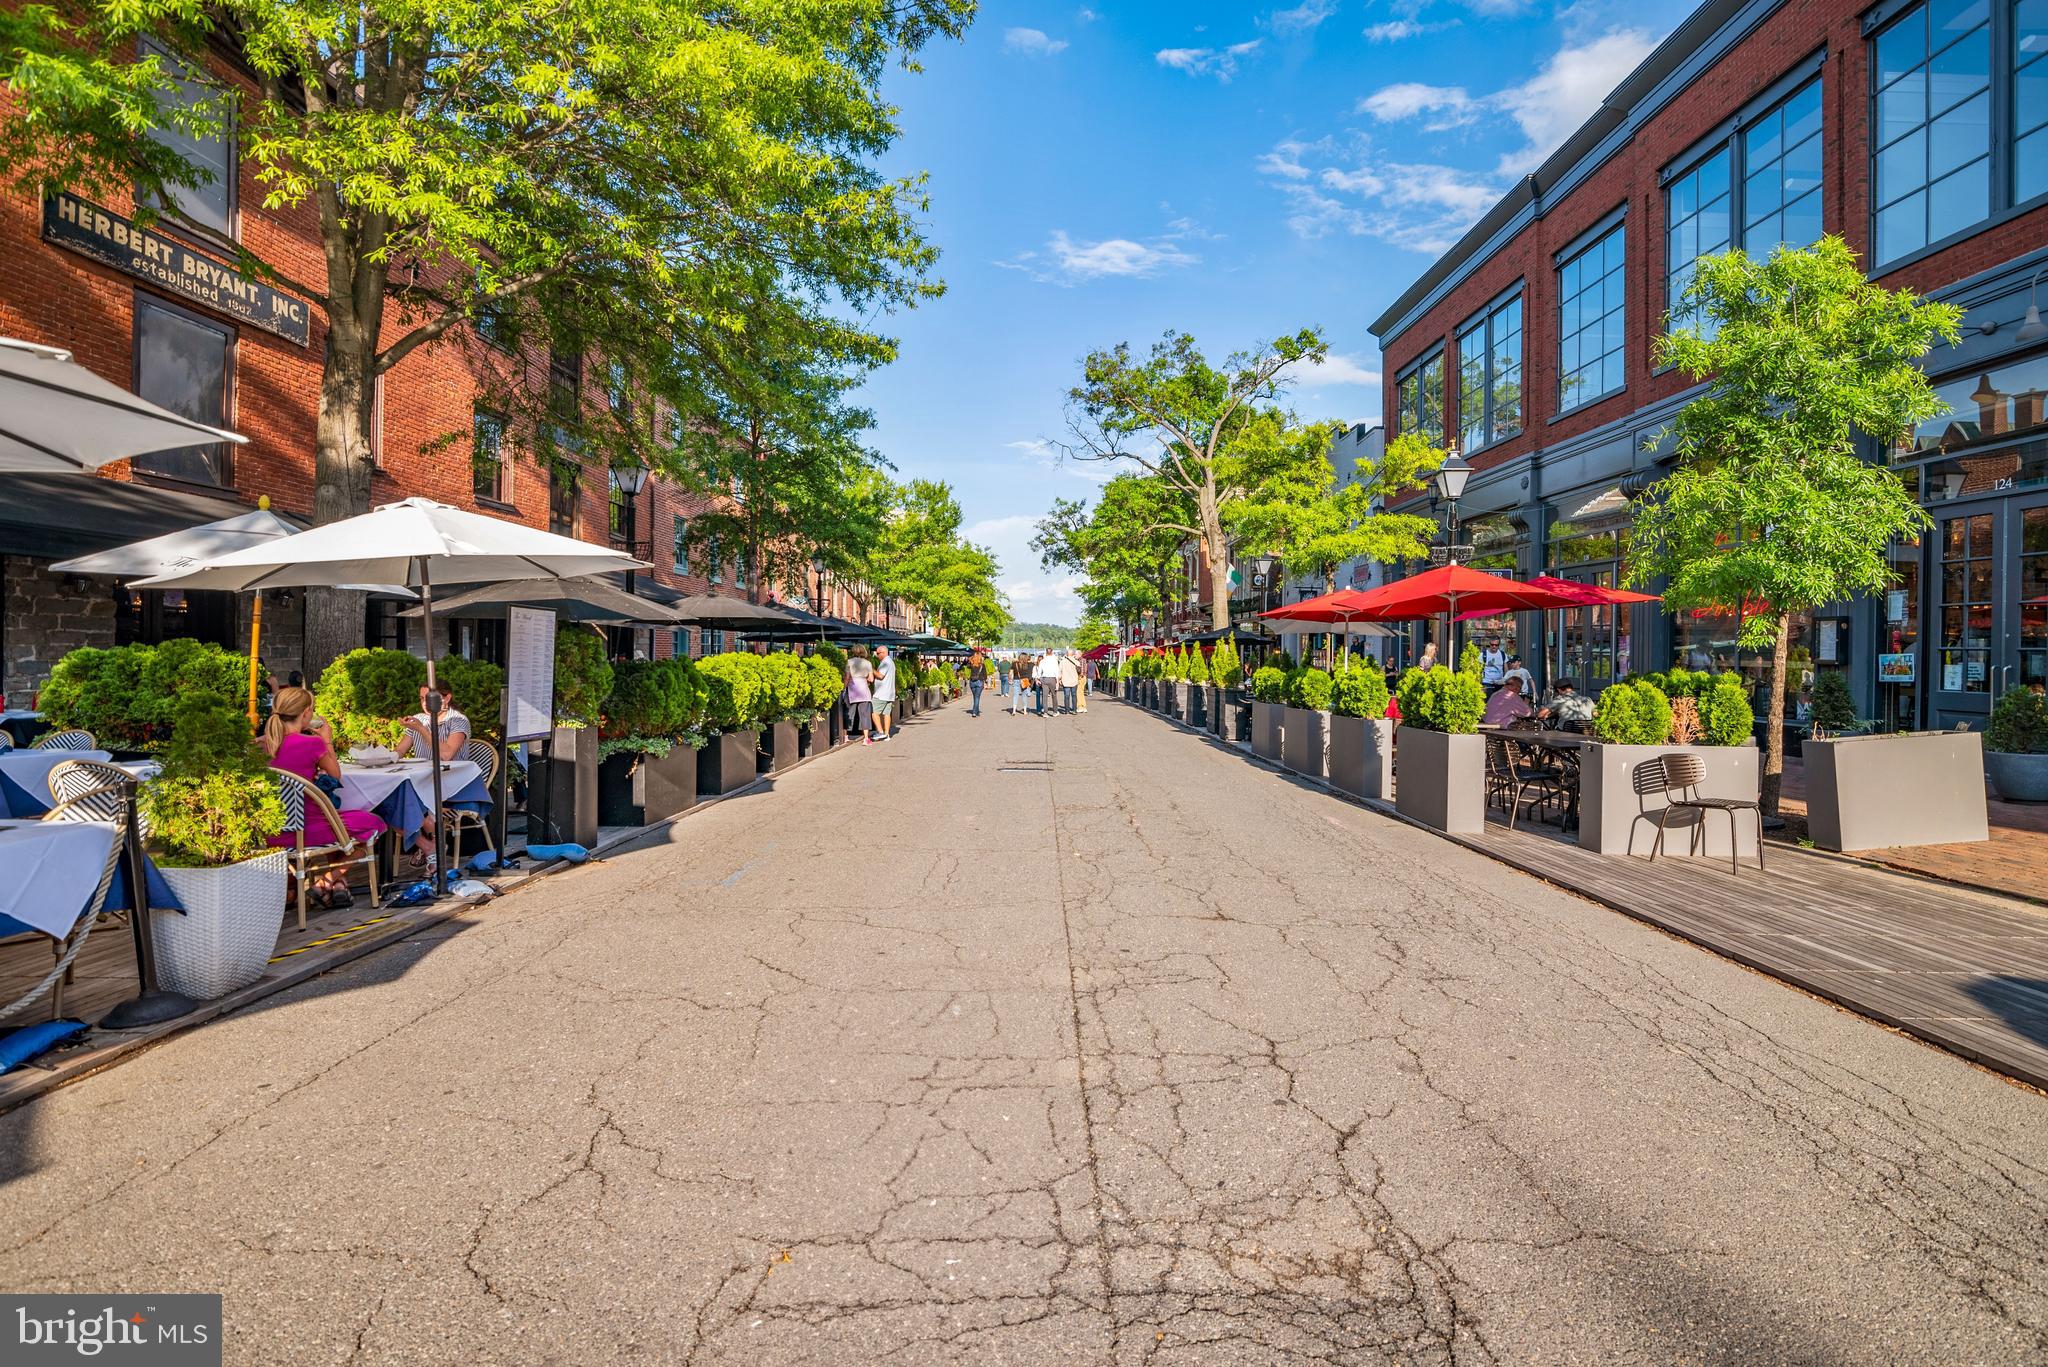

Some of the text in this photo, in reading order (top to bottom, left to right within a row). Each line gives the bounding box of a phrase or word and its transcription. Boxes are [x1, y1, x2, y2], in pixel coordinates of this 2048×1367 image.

[58, 195, 174, 266] HERBERT
[272, 294, 304, 325] INC.
[131, 257, 219, 302] established
[1994, 476, 2013, 491] 124
